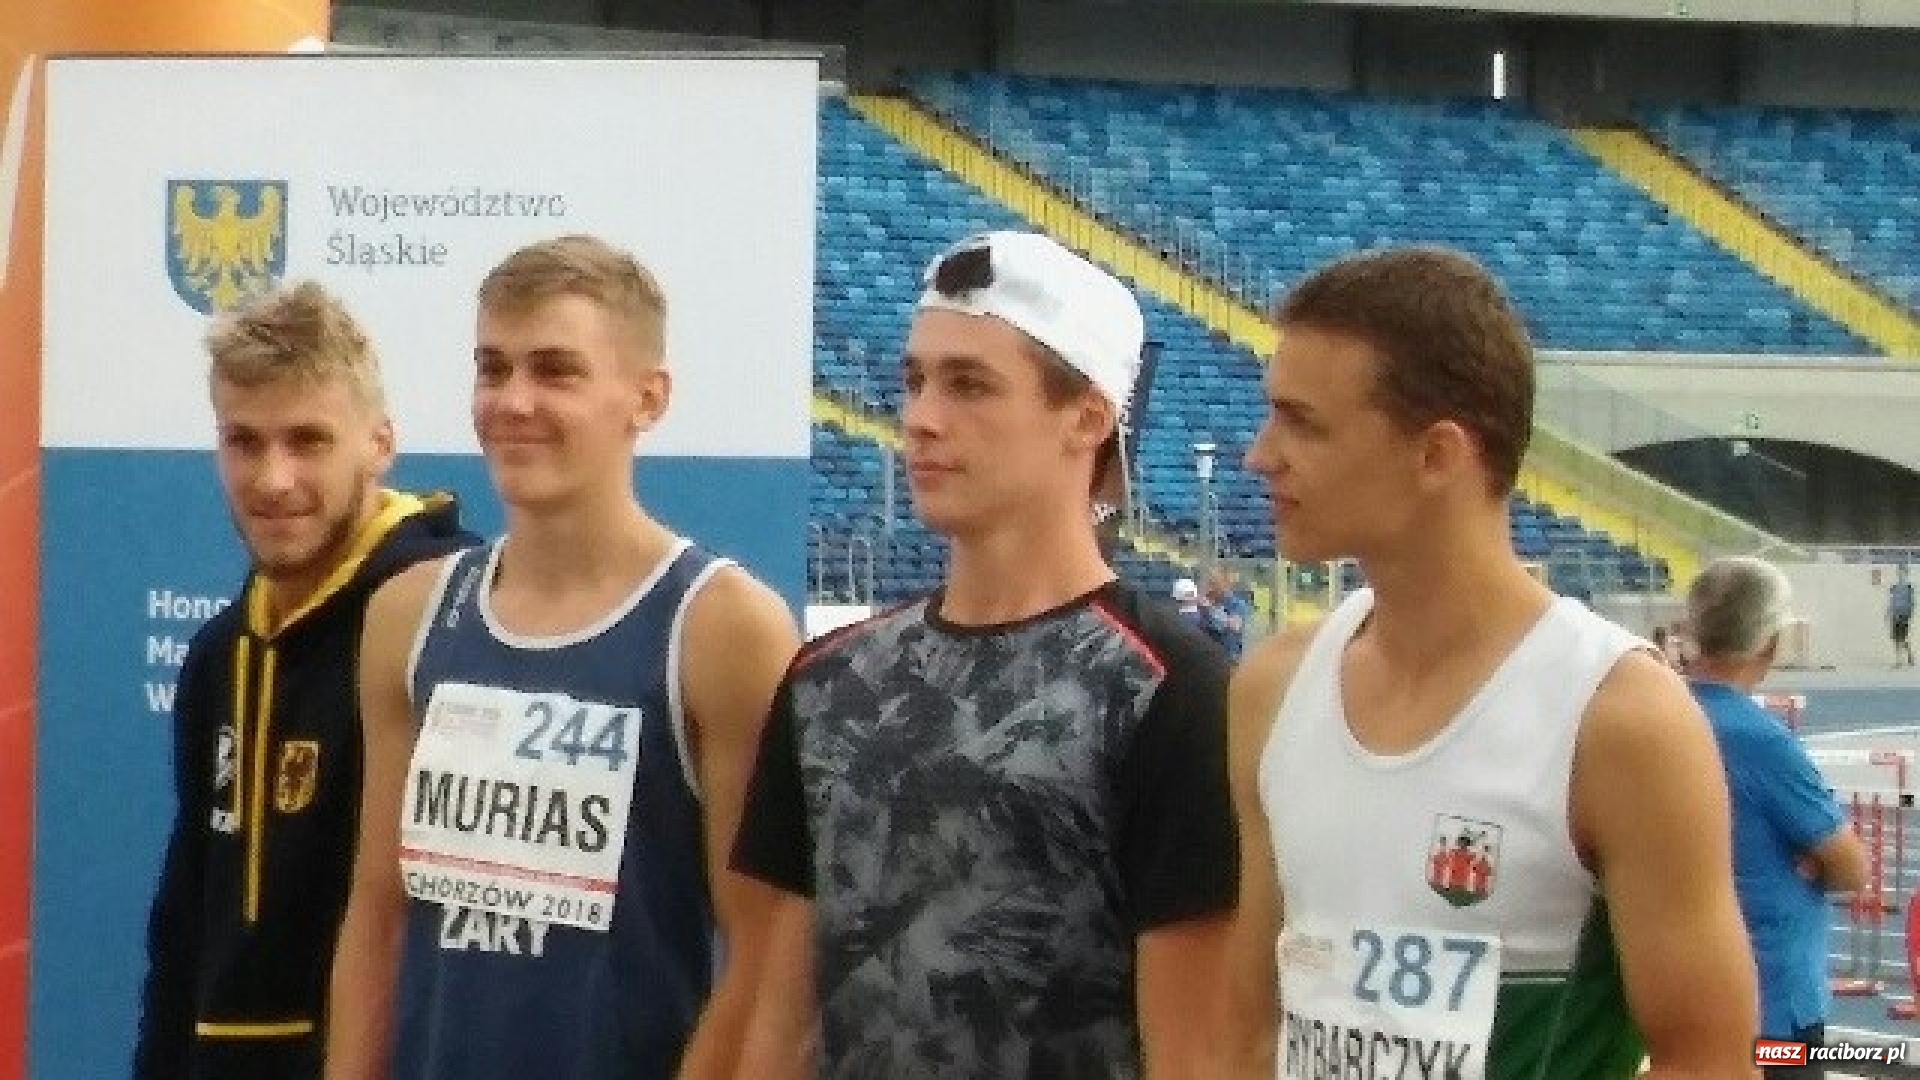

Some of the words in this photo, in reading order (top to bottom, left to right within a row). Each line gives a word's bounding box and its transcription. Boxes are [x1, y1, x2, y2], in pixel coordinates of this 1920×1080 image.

[327, 185, 565, 223] Województwo
[326, 228, 448, 272] Śląskie
[515, 701, 628, 771] 244
[414, 770, 610, 853] MURIAS
[406, 872, 534, 910] CHORZÓW
[541, 895, 604, 925] 2018
[1353, 929, 1488, 1011] 287
